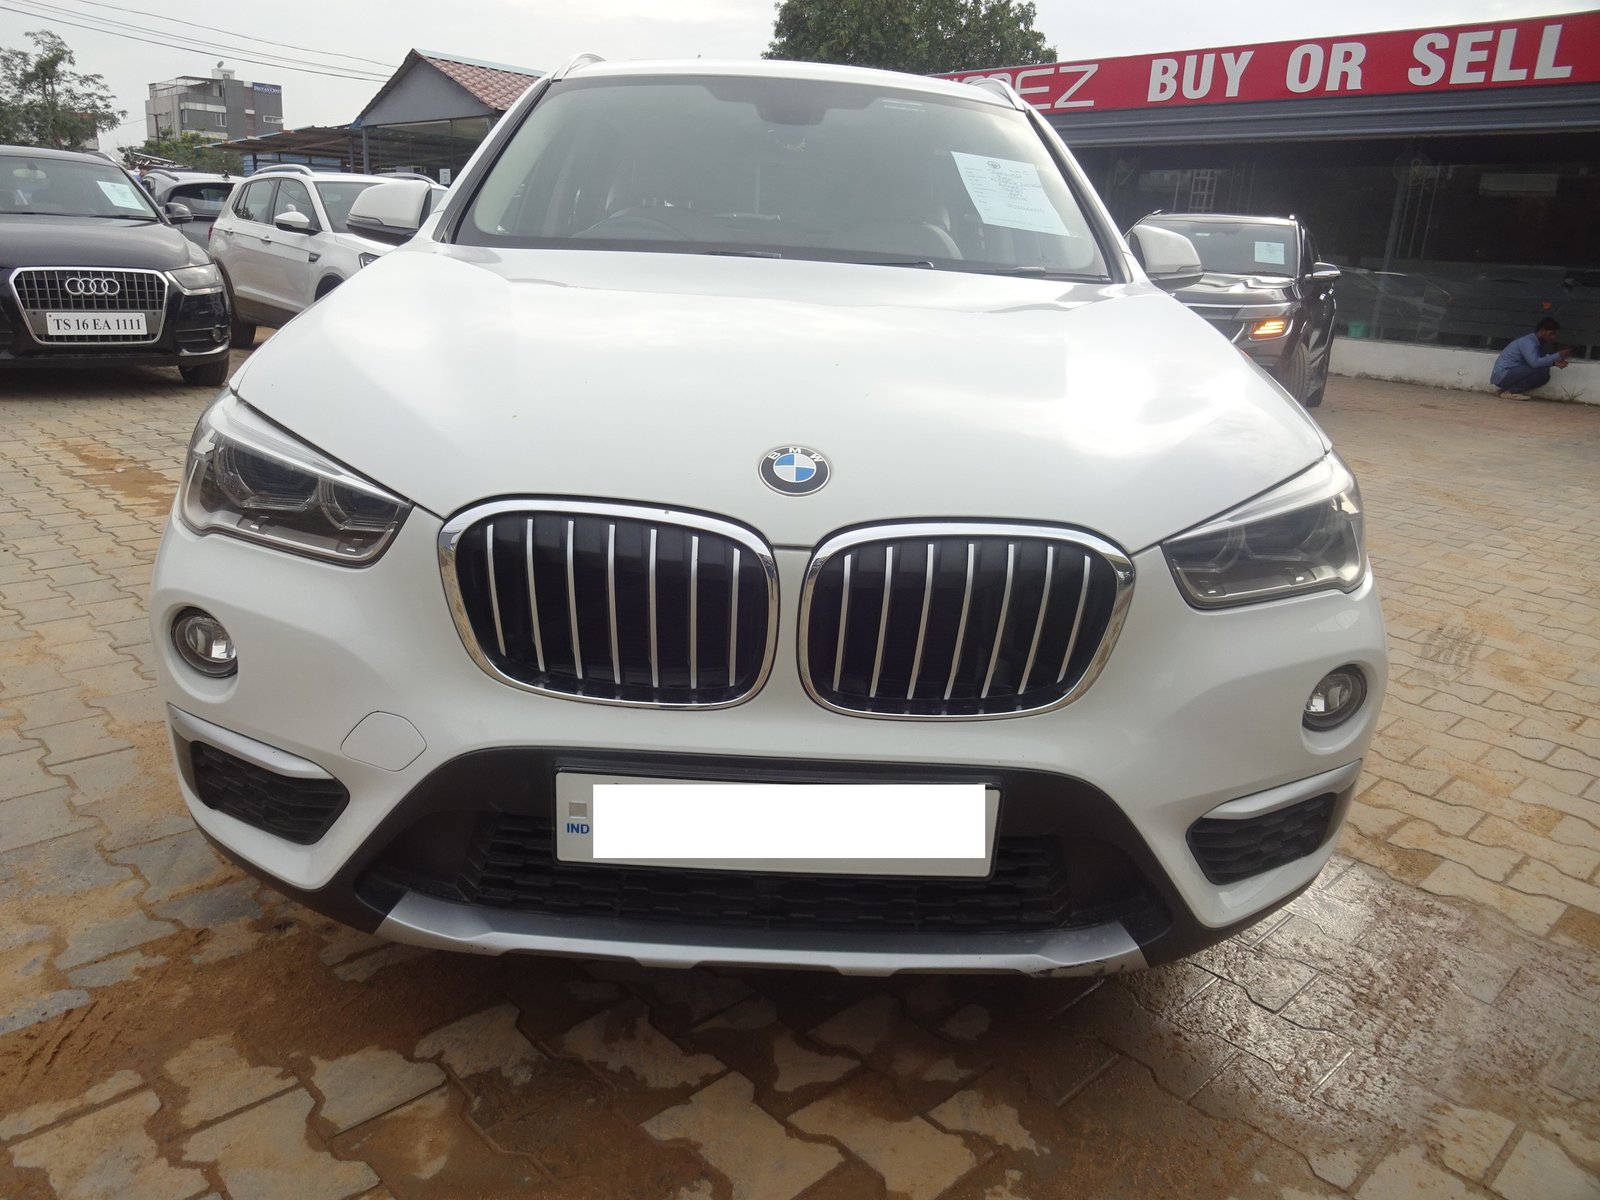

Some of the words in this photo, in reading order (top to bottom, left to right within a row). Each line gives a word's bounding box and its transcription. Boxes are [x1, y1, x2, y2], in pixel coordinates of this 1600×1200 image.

[1147, 51, 1254, 102] BUY
[1286, 42, 1366, 93] OR
[1408, 24, 1572, 86] SELL
[53, 319, 71, 330] TS
[75, 319, 89, 330] 16
[92, 319, 112, 330] EA
[116, 319, 141, 330] 1111
[768, 447, 824, 462] BMW
[566, 823, 590, 834] IND
